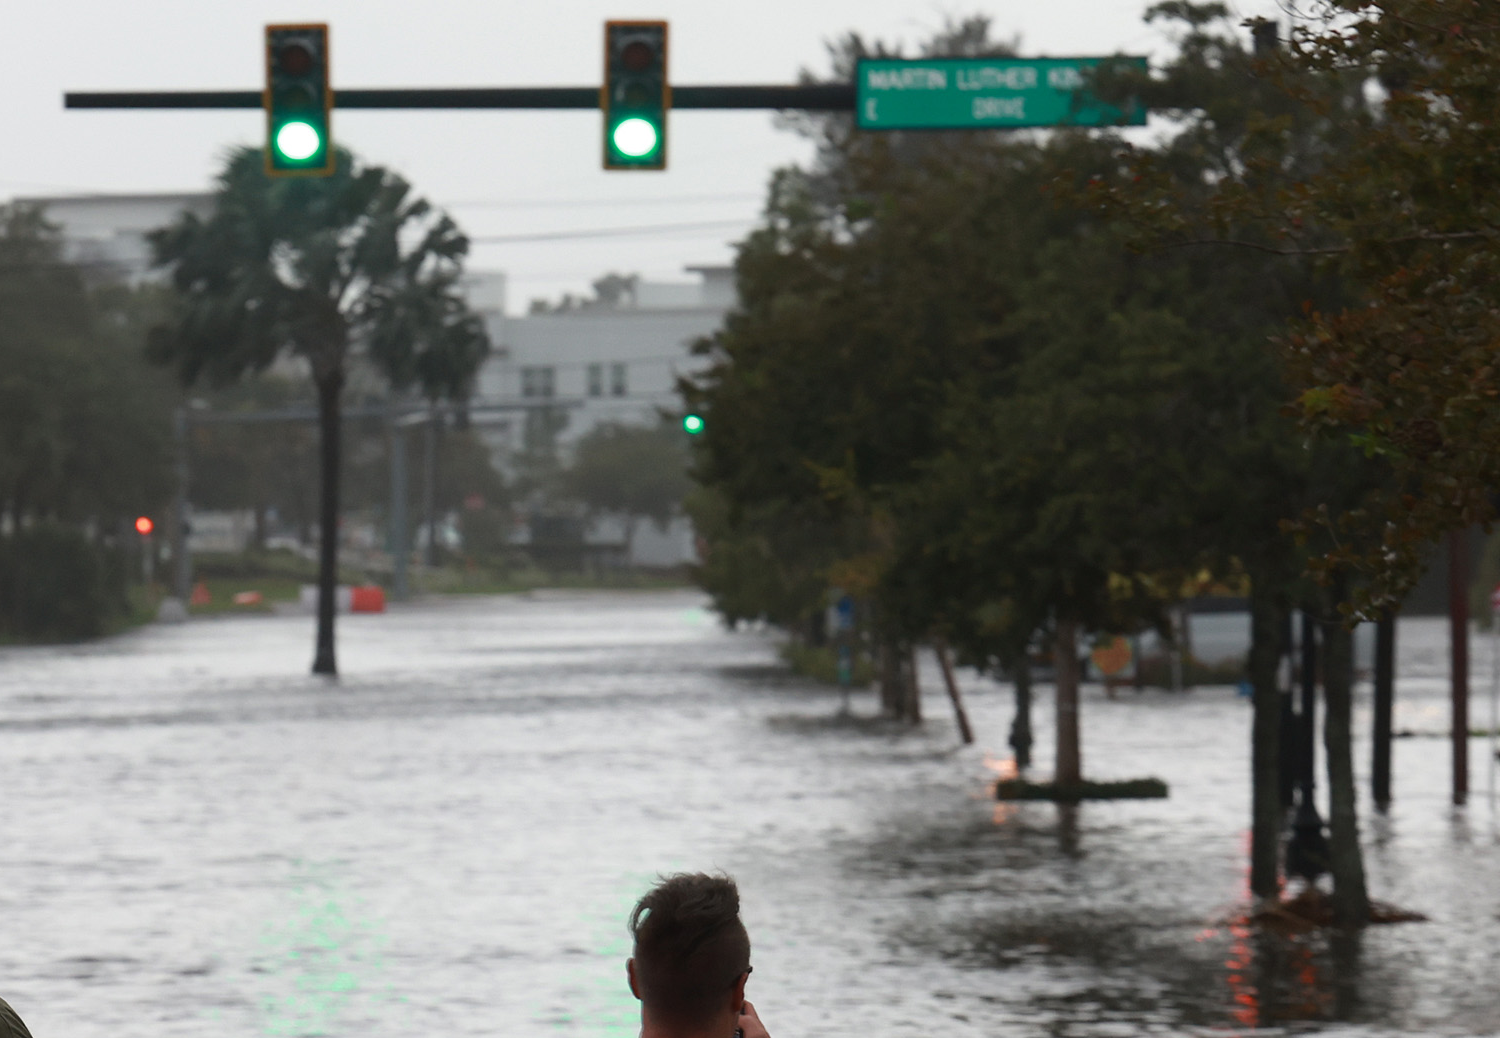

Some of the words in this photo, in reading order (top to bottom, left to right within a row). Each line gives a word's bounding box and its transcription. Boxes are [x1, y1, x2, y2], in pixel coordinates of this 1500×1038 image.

[868, 67, 947, 90] MARTIN
[956, 66, 1037, 90] LUTHER
[971, 96, 1026, 119] DRIVE
